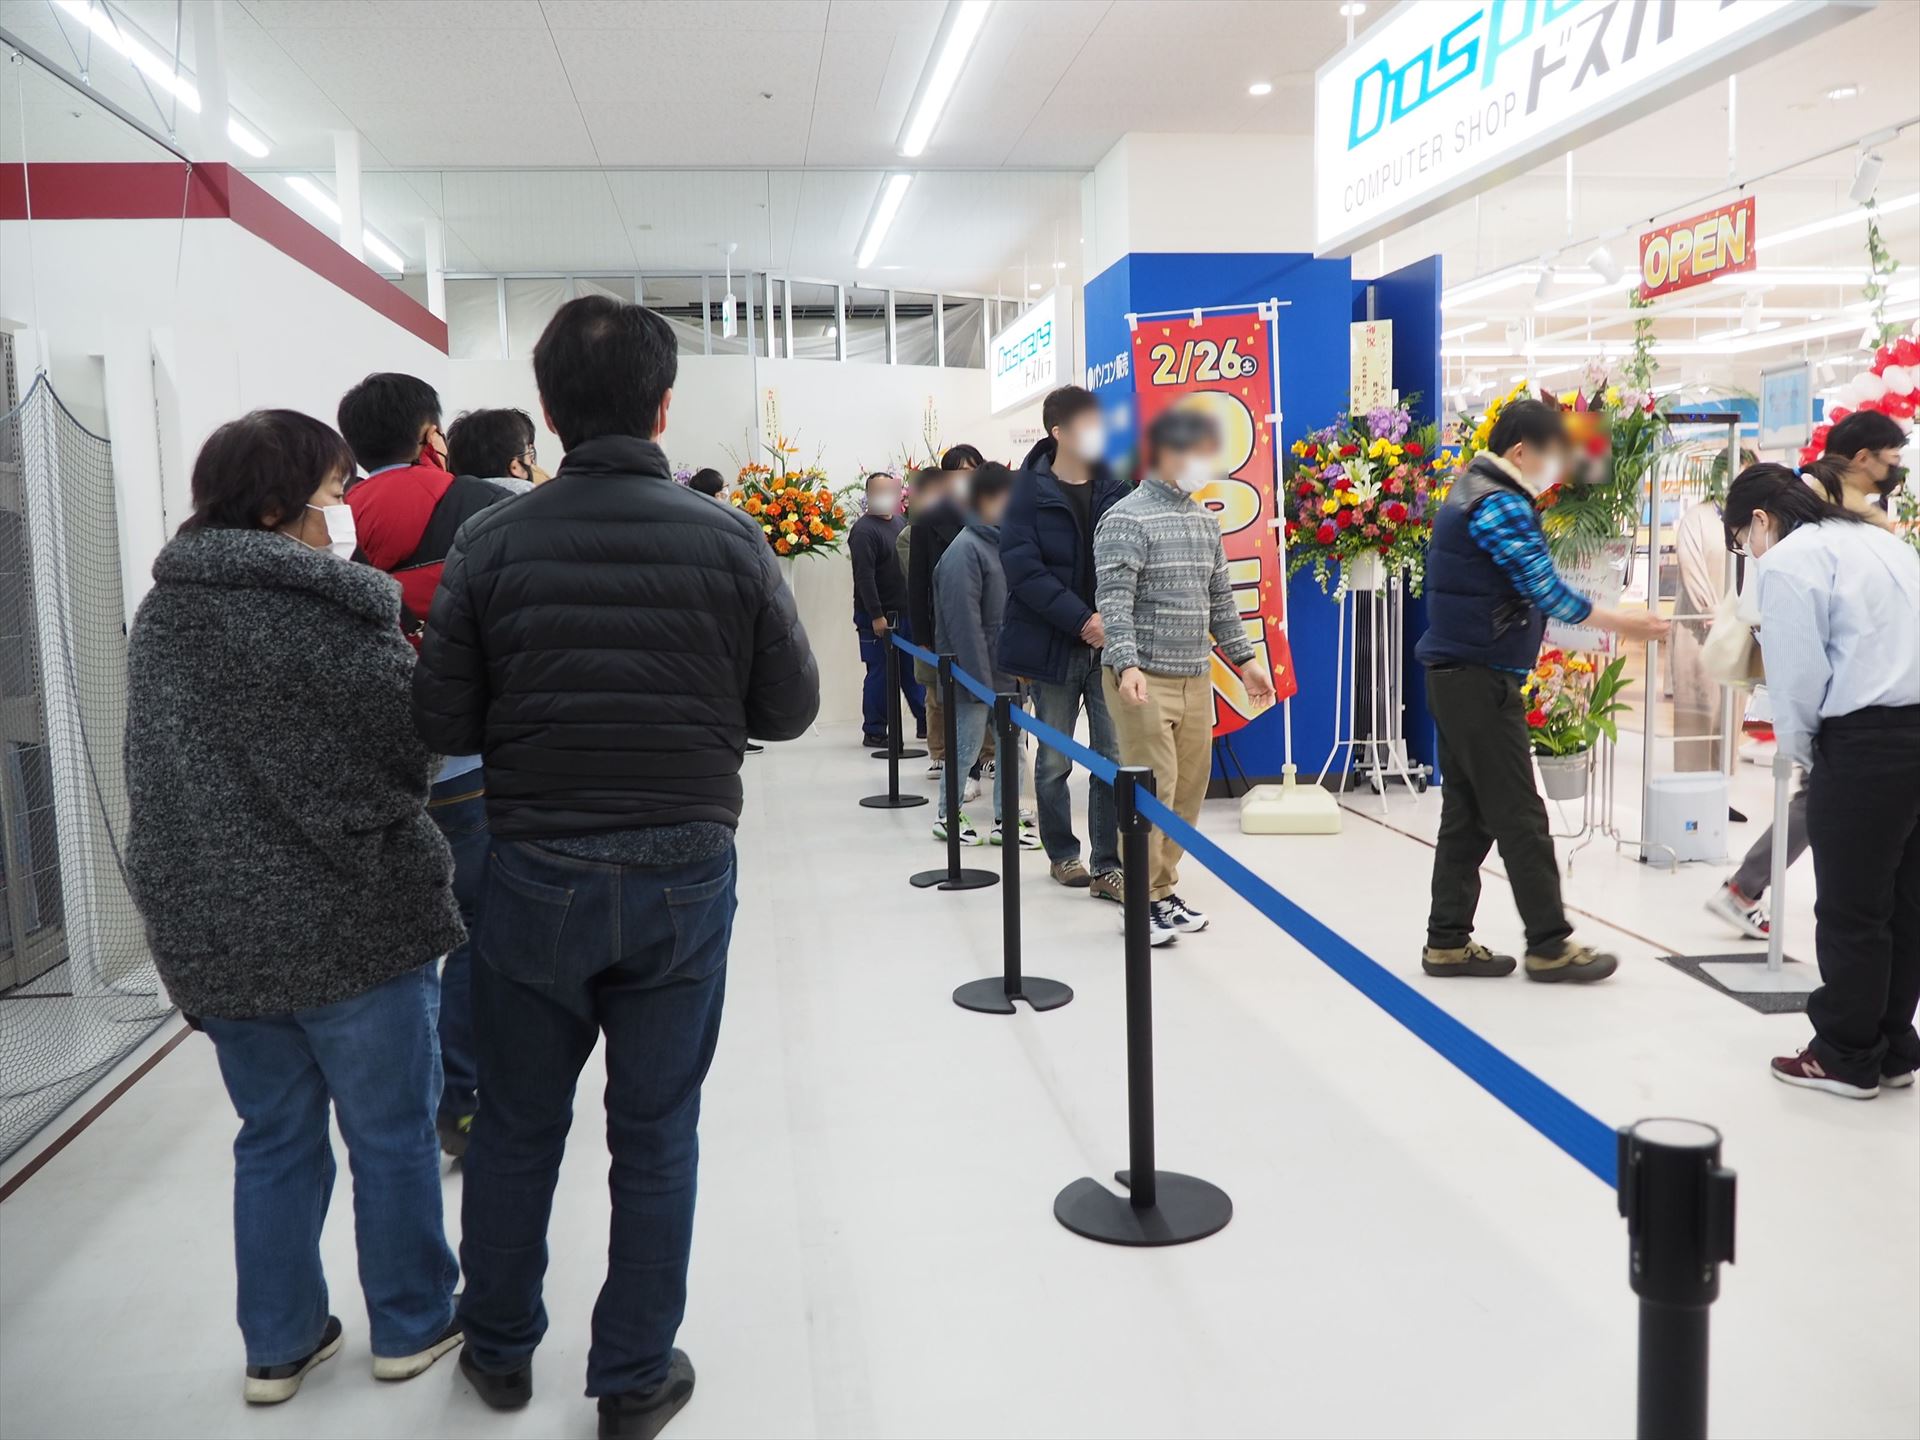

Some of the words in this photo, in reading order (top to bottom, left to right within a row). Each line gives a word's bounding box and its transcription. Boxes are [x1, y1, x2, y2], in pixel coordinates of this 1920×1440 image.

[1344, 134, 1443, 213] COMPUTER
[1454, 91, 1517, 155] SHOP
[1642, 207, 1747, 289] OPEN
